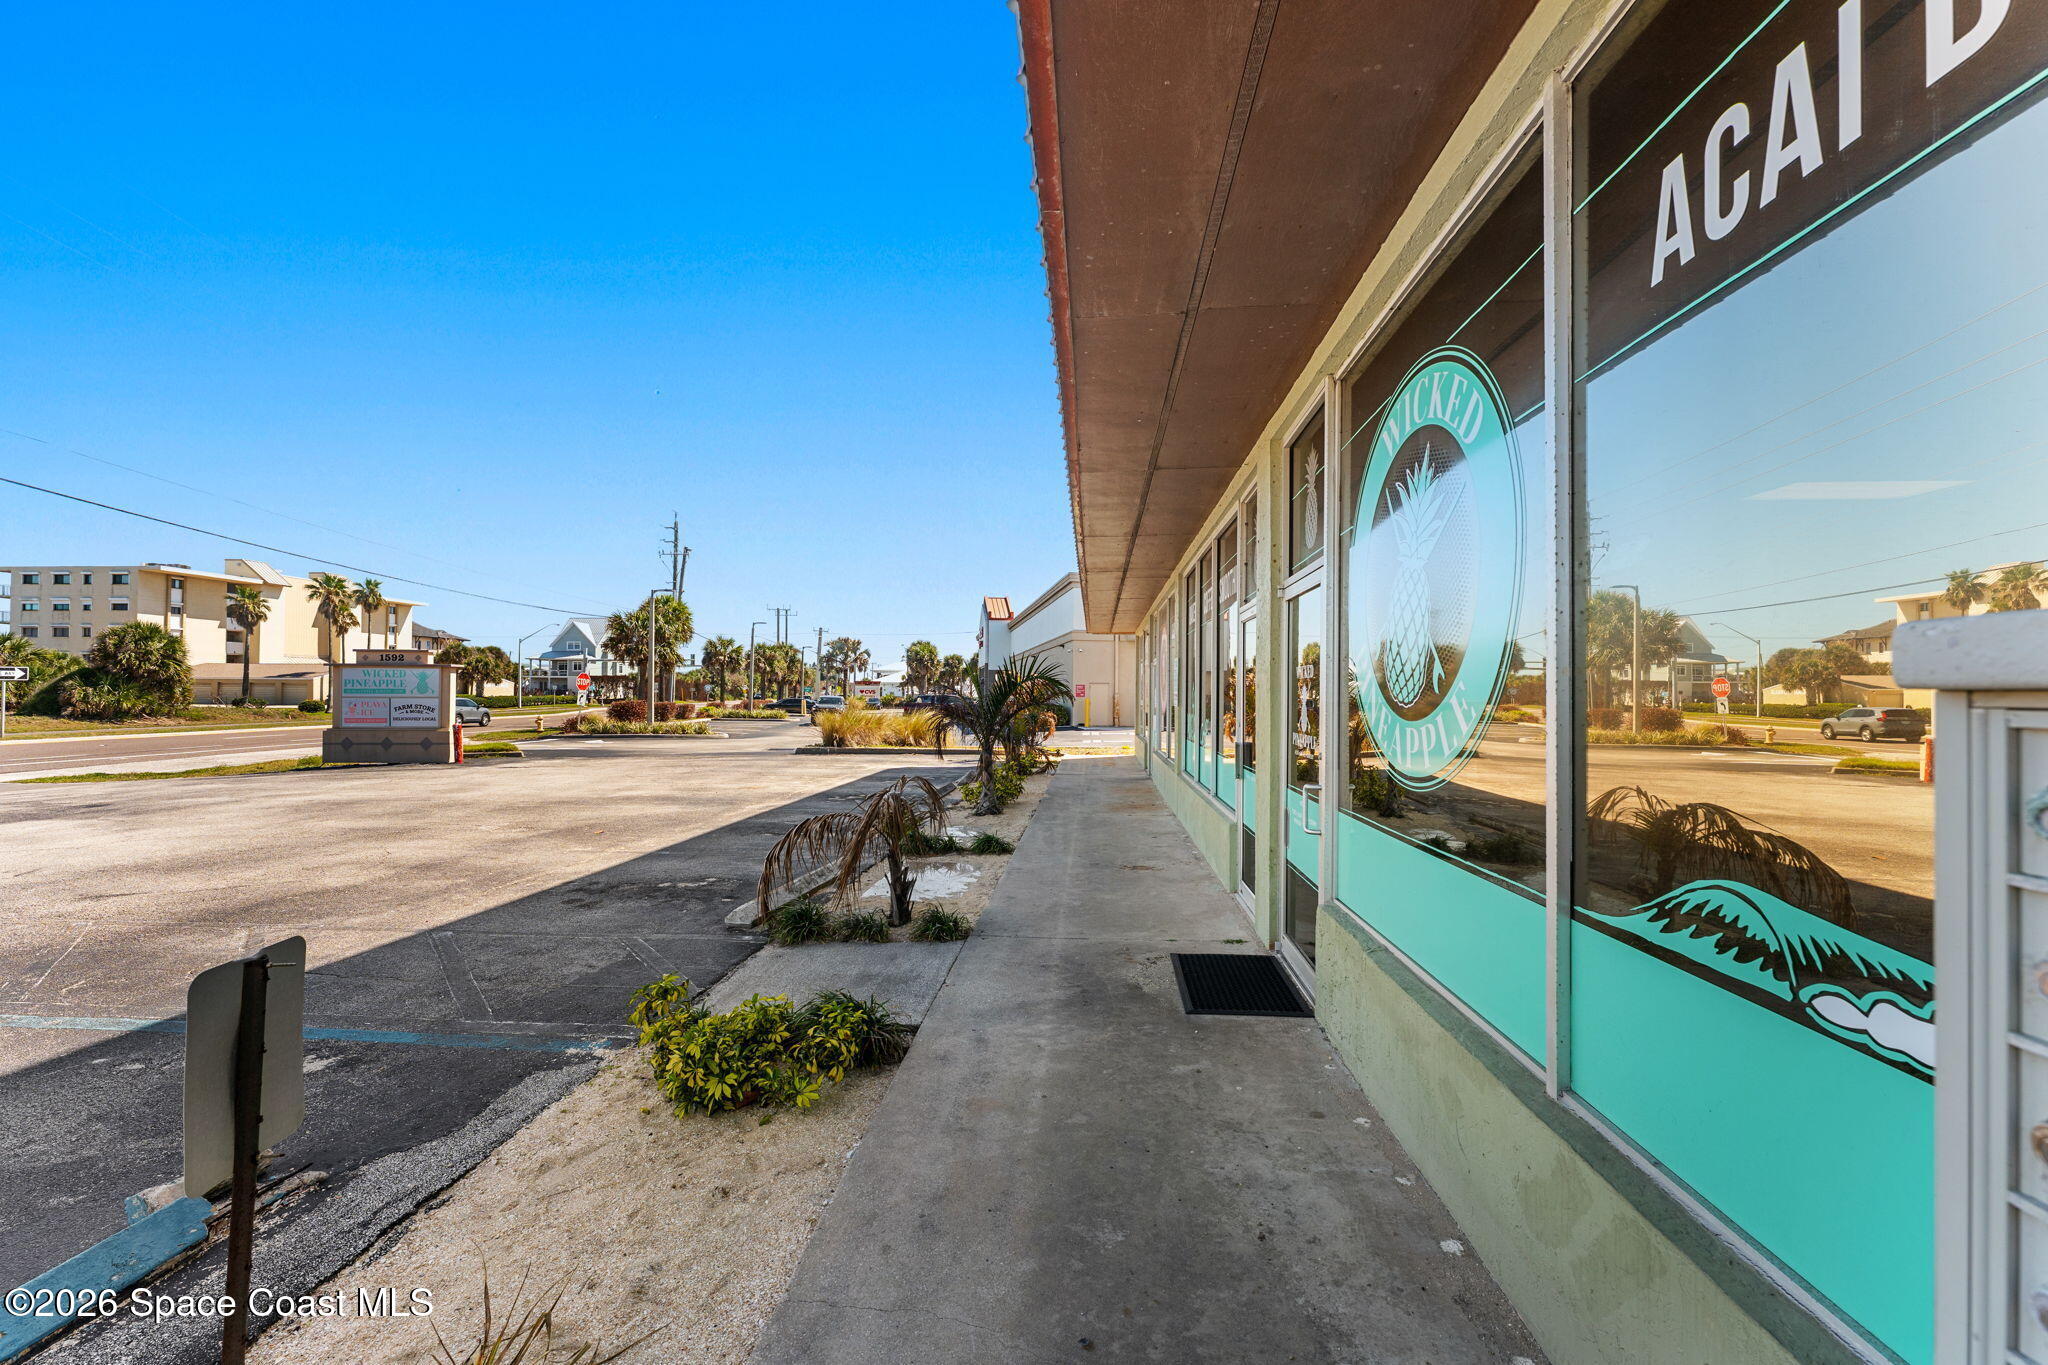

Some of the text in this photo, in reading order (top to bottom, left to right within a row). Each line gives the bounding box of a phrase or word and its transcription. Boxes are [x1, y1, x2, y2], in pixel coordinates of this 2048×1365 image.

[1651, 0, 1862, 287] ACAI
[1383, 371, 1484, 457] WICKED
[363, 670, 406, 678] WICKED
[576, 678, 590, 686] STOP
[394, 704, 436, 713] FARM STORE
